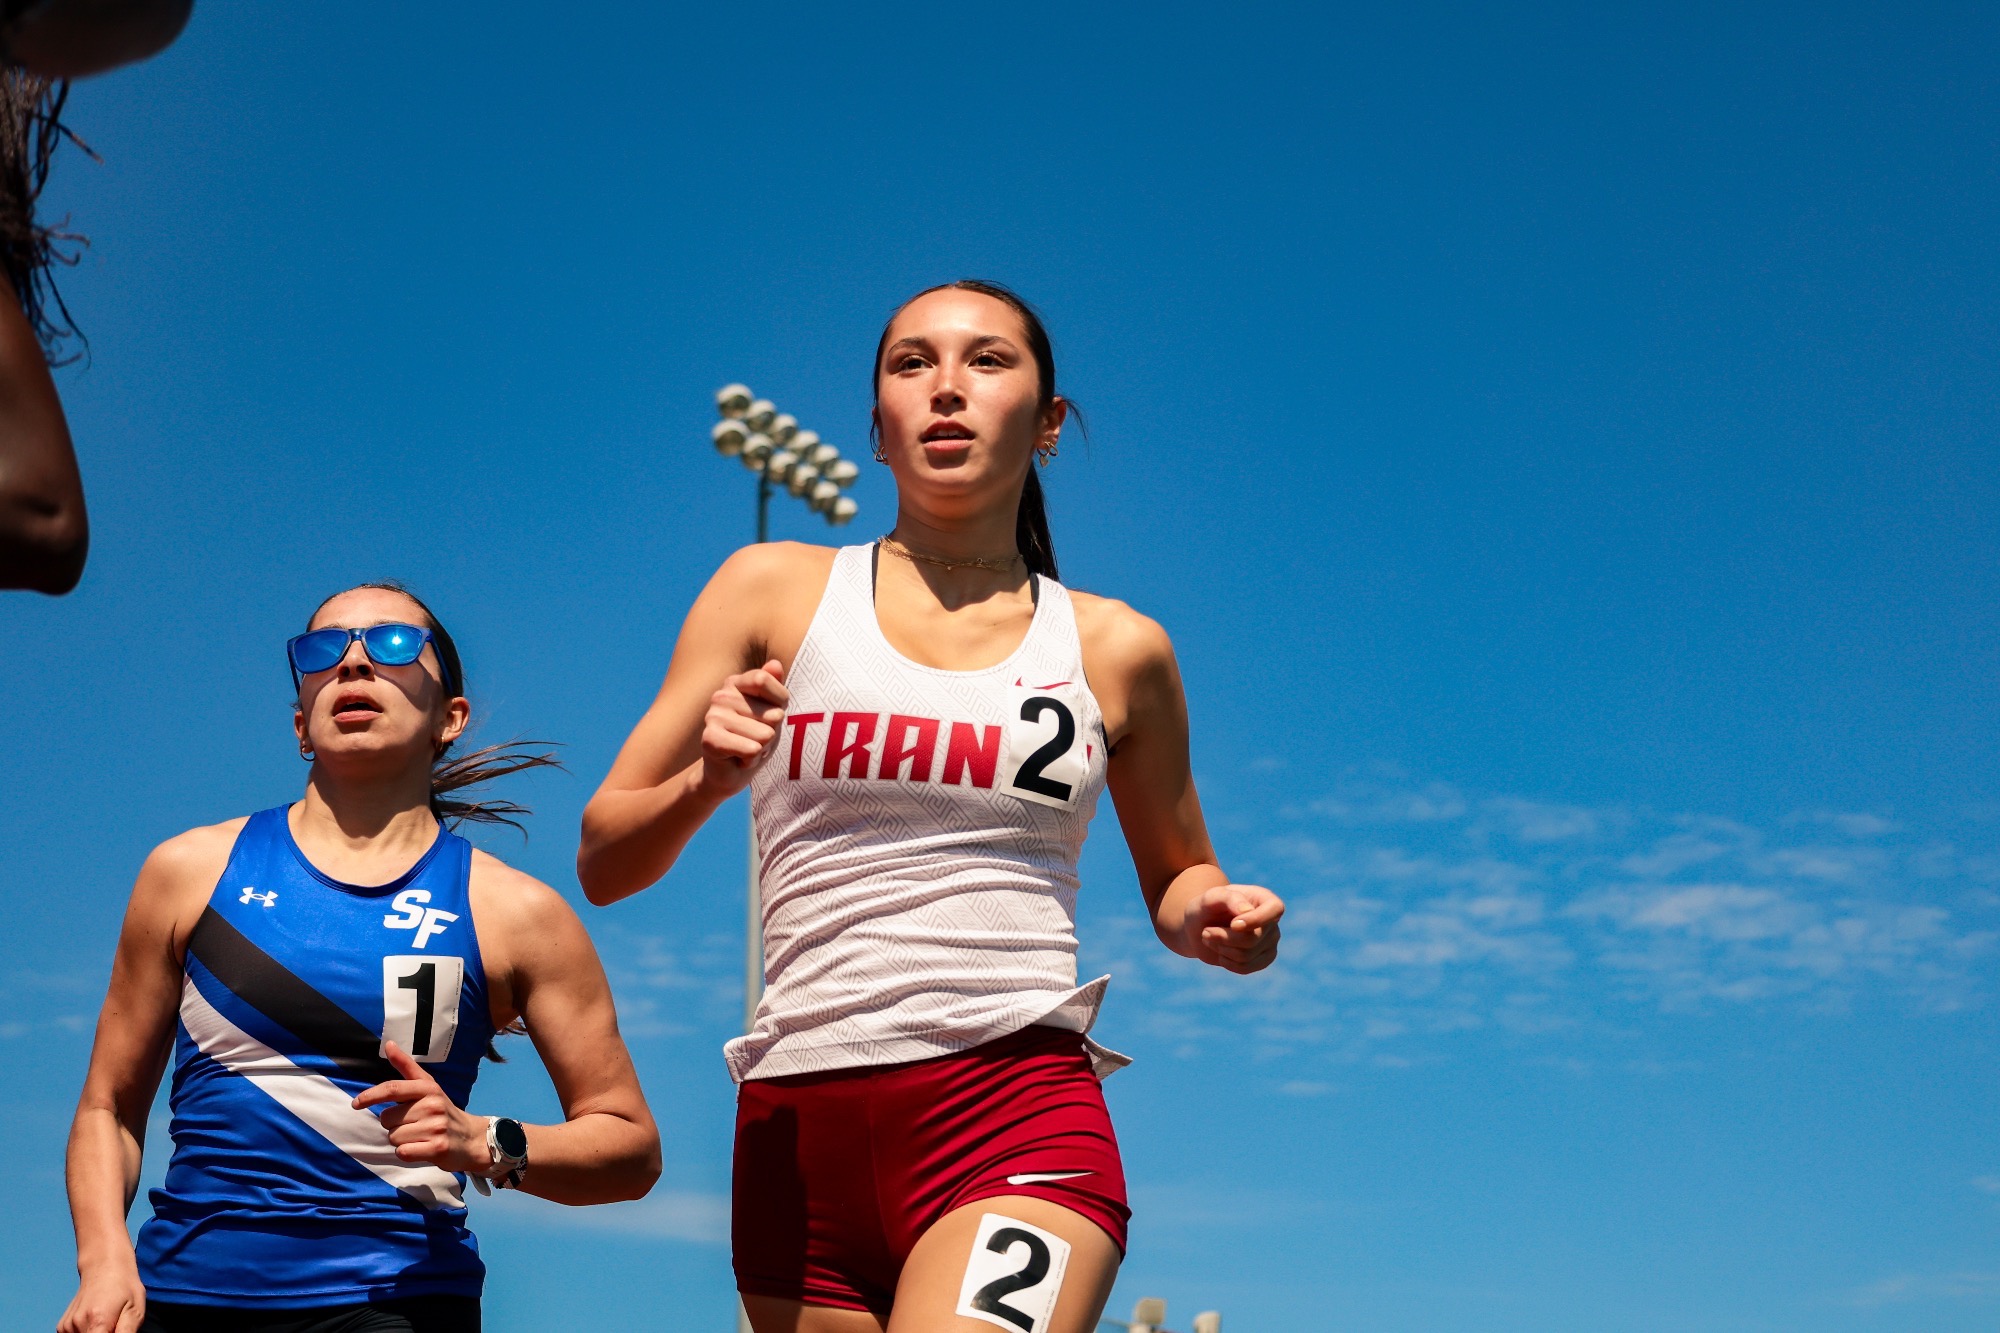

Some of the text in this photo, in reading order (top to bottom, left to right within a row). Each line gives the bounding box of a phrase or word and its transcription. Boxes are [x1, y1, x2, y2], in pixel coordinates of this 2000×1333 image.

[787, 711, 1002, 789] TRAN
[1012, 696, 1075, 802] 2
[383, 889, 460, 949] SF
[397, 962, 436, 1056] 1
[969, 1227, 1051, 1333] 2
